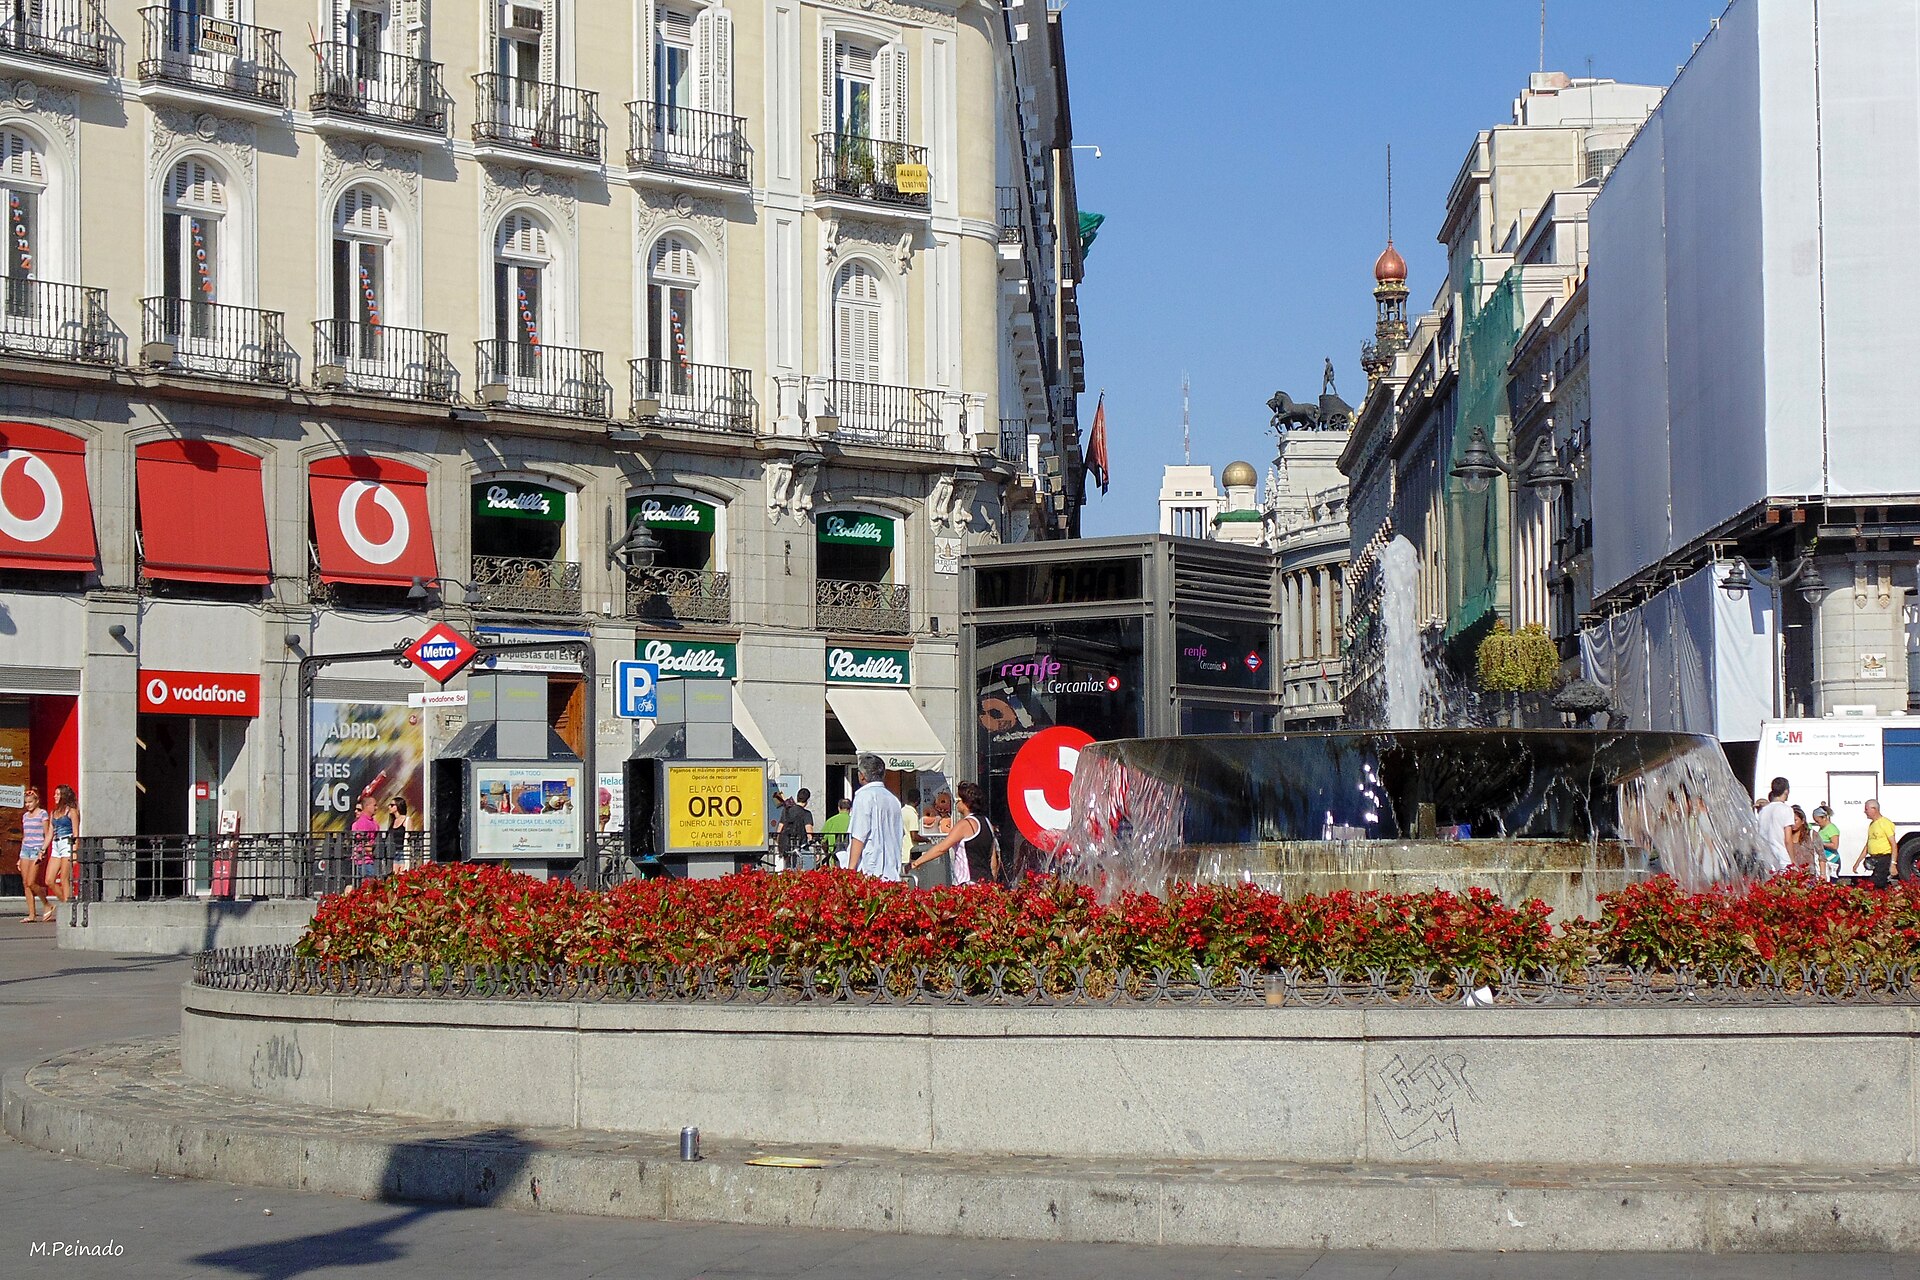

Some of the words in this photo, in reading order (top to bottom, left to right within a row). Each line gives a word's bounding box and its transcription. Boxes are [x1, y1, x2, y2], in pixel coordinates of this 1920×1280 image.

[202, 18, 212, 30] SE
[212, 22, 237, 37] ALQUILA
[900, 169, 922, 177] ALQUILO
[486, 485, 550, 515] Rodilla
[641, 499, 700, 525] Rodilla
[826, 515, 882, 542] Rodilla
[423, 645, 454, 659] Metro
[544, 649, 557, 660] del
[645, 640, 725, 677] Rodilla
[1183, 644, 1208, 661] renfe
[829, 648, 903, 684] Rodilla
[1001, 655, 1061, 683] renfe
[172, 683, 246, 703] vodafone
[626, 667, 652, 712] P
[1047, 678, 1104, 694] Cercanías
[428, 695, 455, 703] vodafone
[456, 694, 466, 702] Sol
[314, 721, 381, 741] MADRID,
[315, 763, 350, 778] ERES
[889, 757, 915, 769] Rodilla
[315, 782, 350, 812] 4G
[689, 785, 699, 794] EL
[701, 785, 723, 793] PAYO
[725, 785, 741, 793] DEL
[688, 795, 743, 818] ORO
[680, 820, 706, 828] DINERO
[719, 819, 752, 827] INSTANTE
